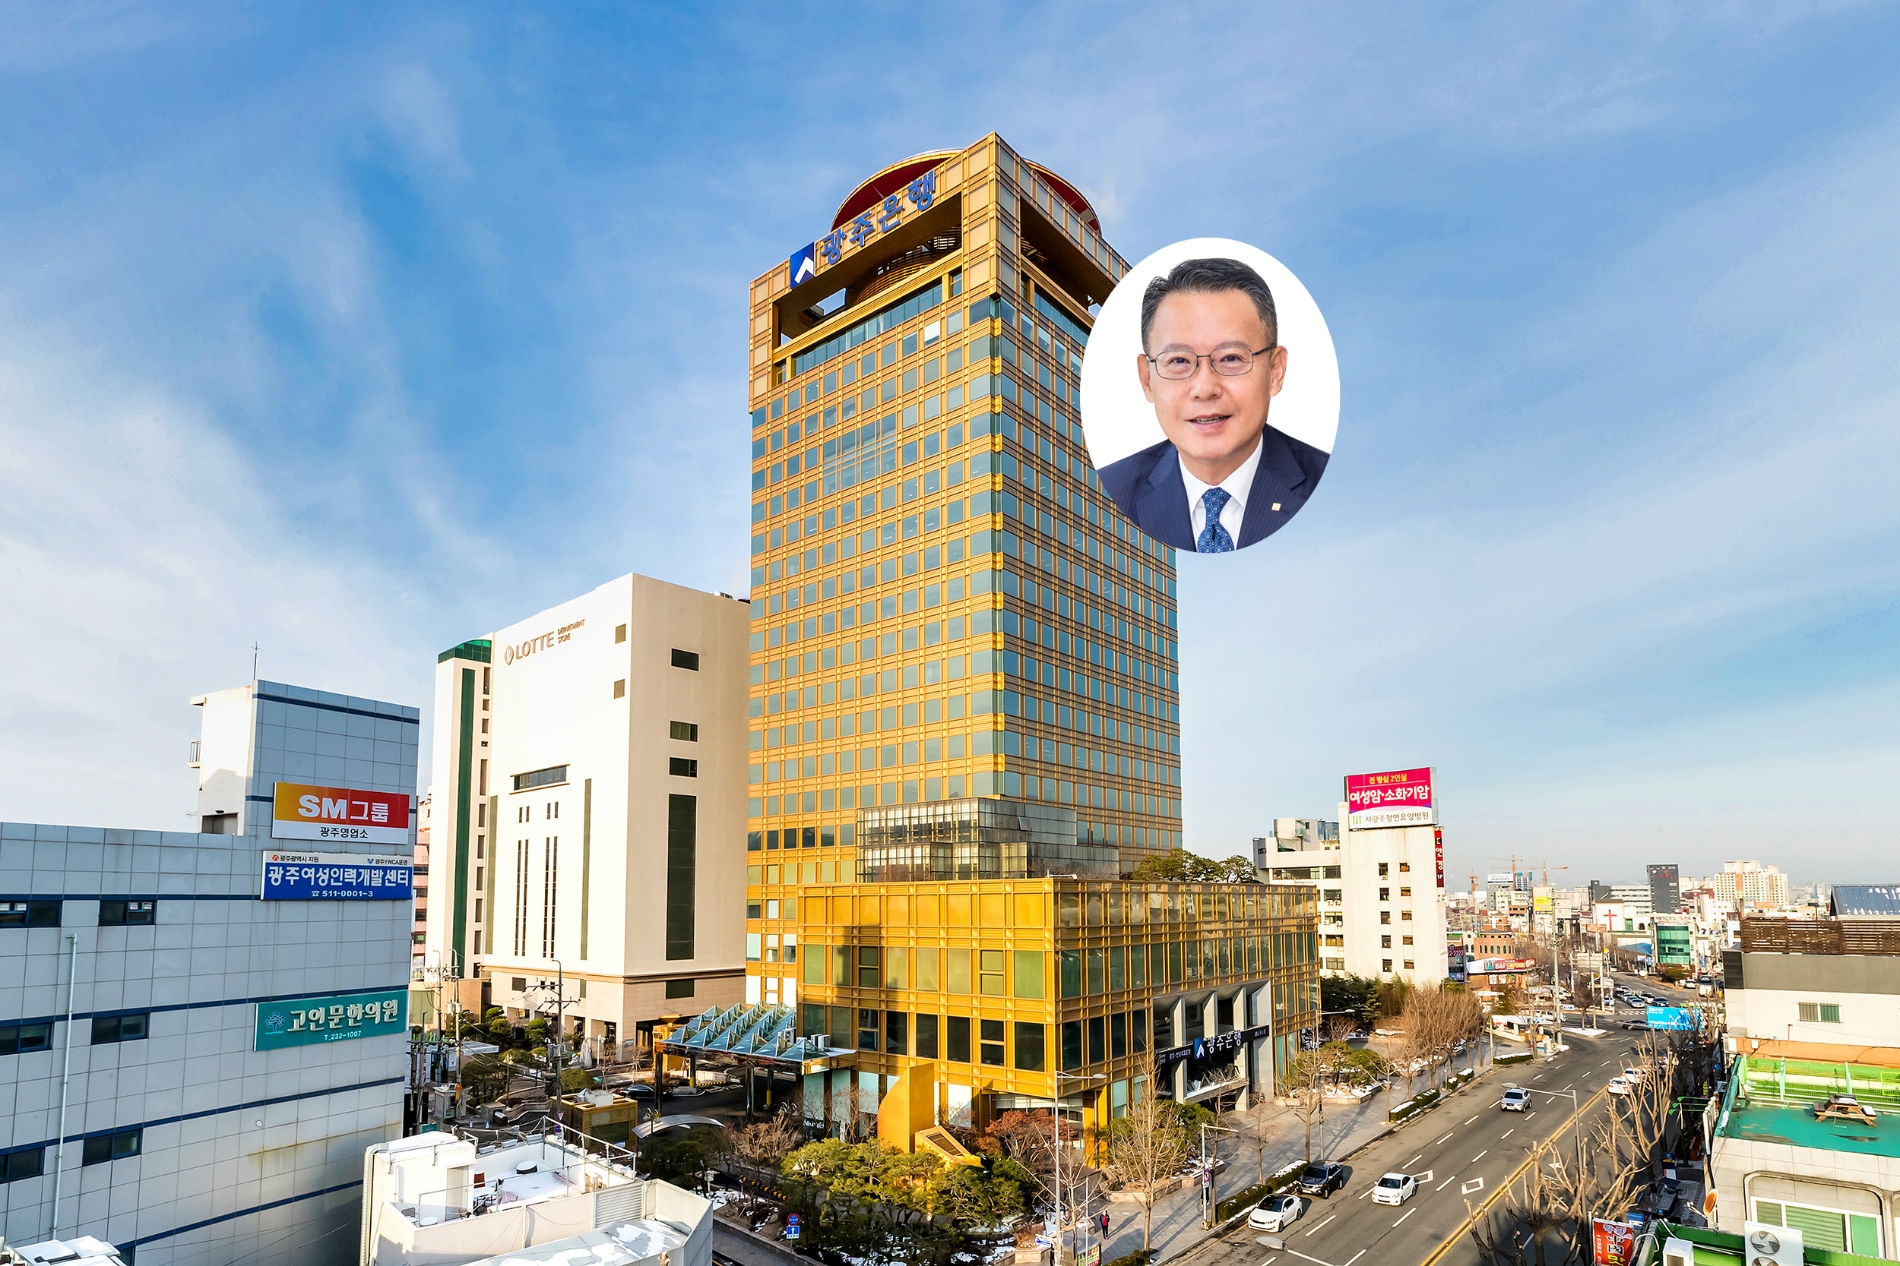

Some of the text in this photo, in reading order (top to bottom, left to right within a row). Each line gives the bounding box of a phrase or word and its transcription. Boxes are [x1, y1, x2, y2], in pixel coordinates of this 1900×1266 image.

[821, 170, 936, 265] 광주은행
[515, 631, 555, 660] LOTTE
[1350, 784, 1430, 805] 여성암·소화기암
[297, 794, 389, 824] SM그룹
[320, 826, 369, 839] 광주영업소
[280, 854, 307, 863] 광주광역시
[287, 999, 399, 1033] 고인문한의원
[324, 1030, 362, 1042] T.232-1007
[1206, 1029, 1242, 1054] 광주은행
